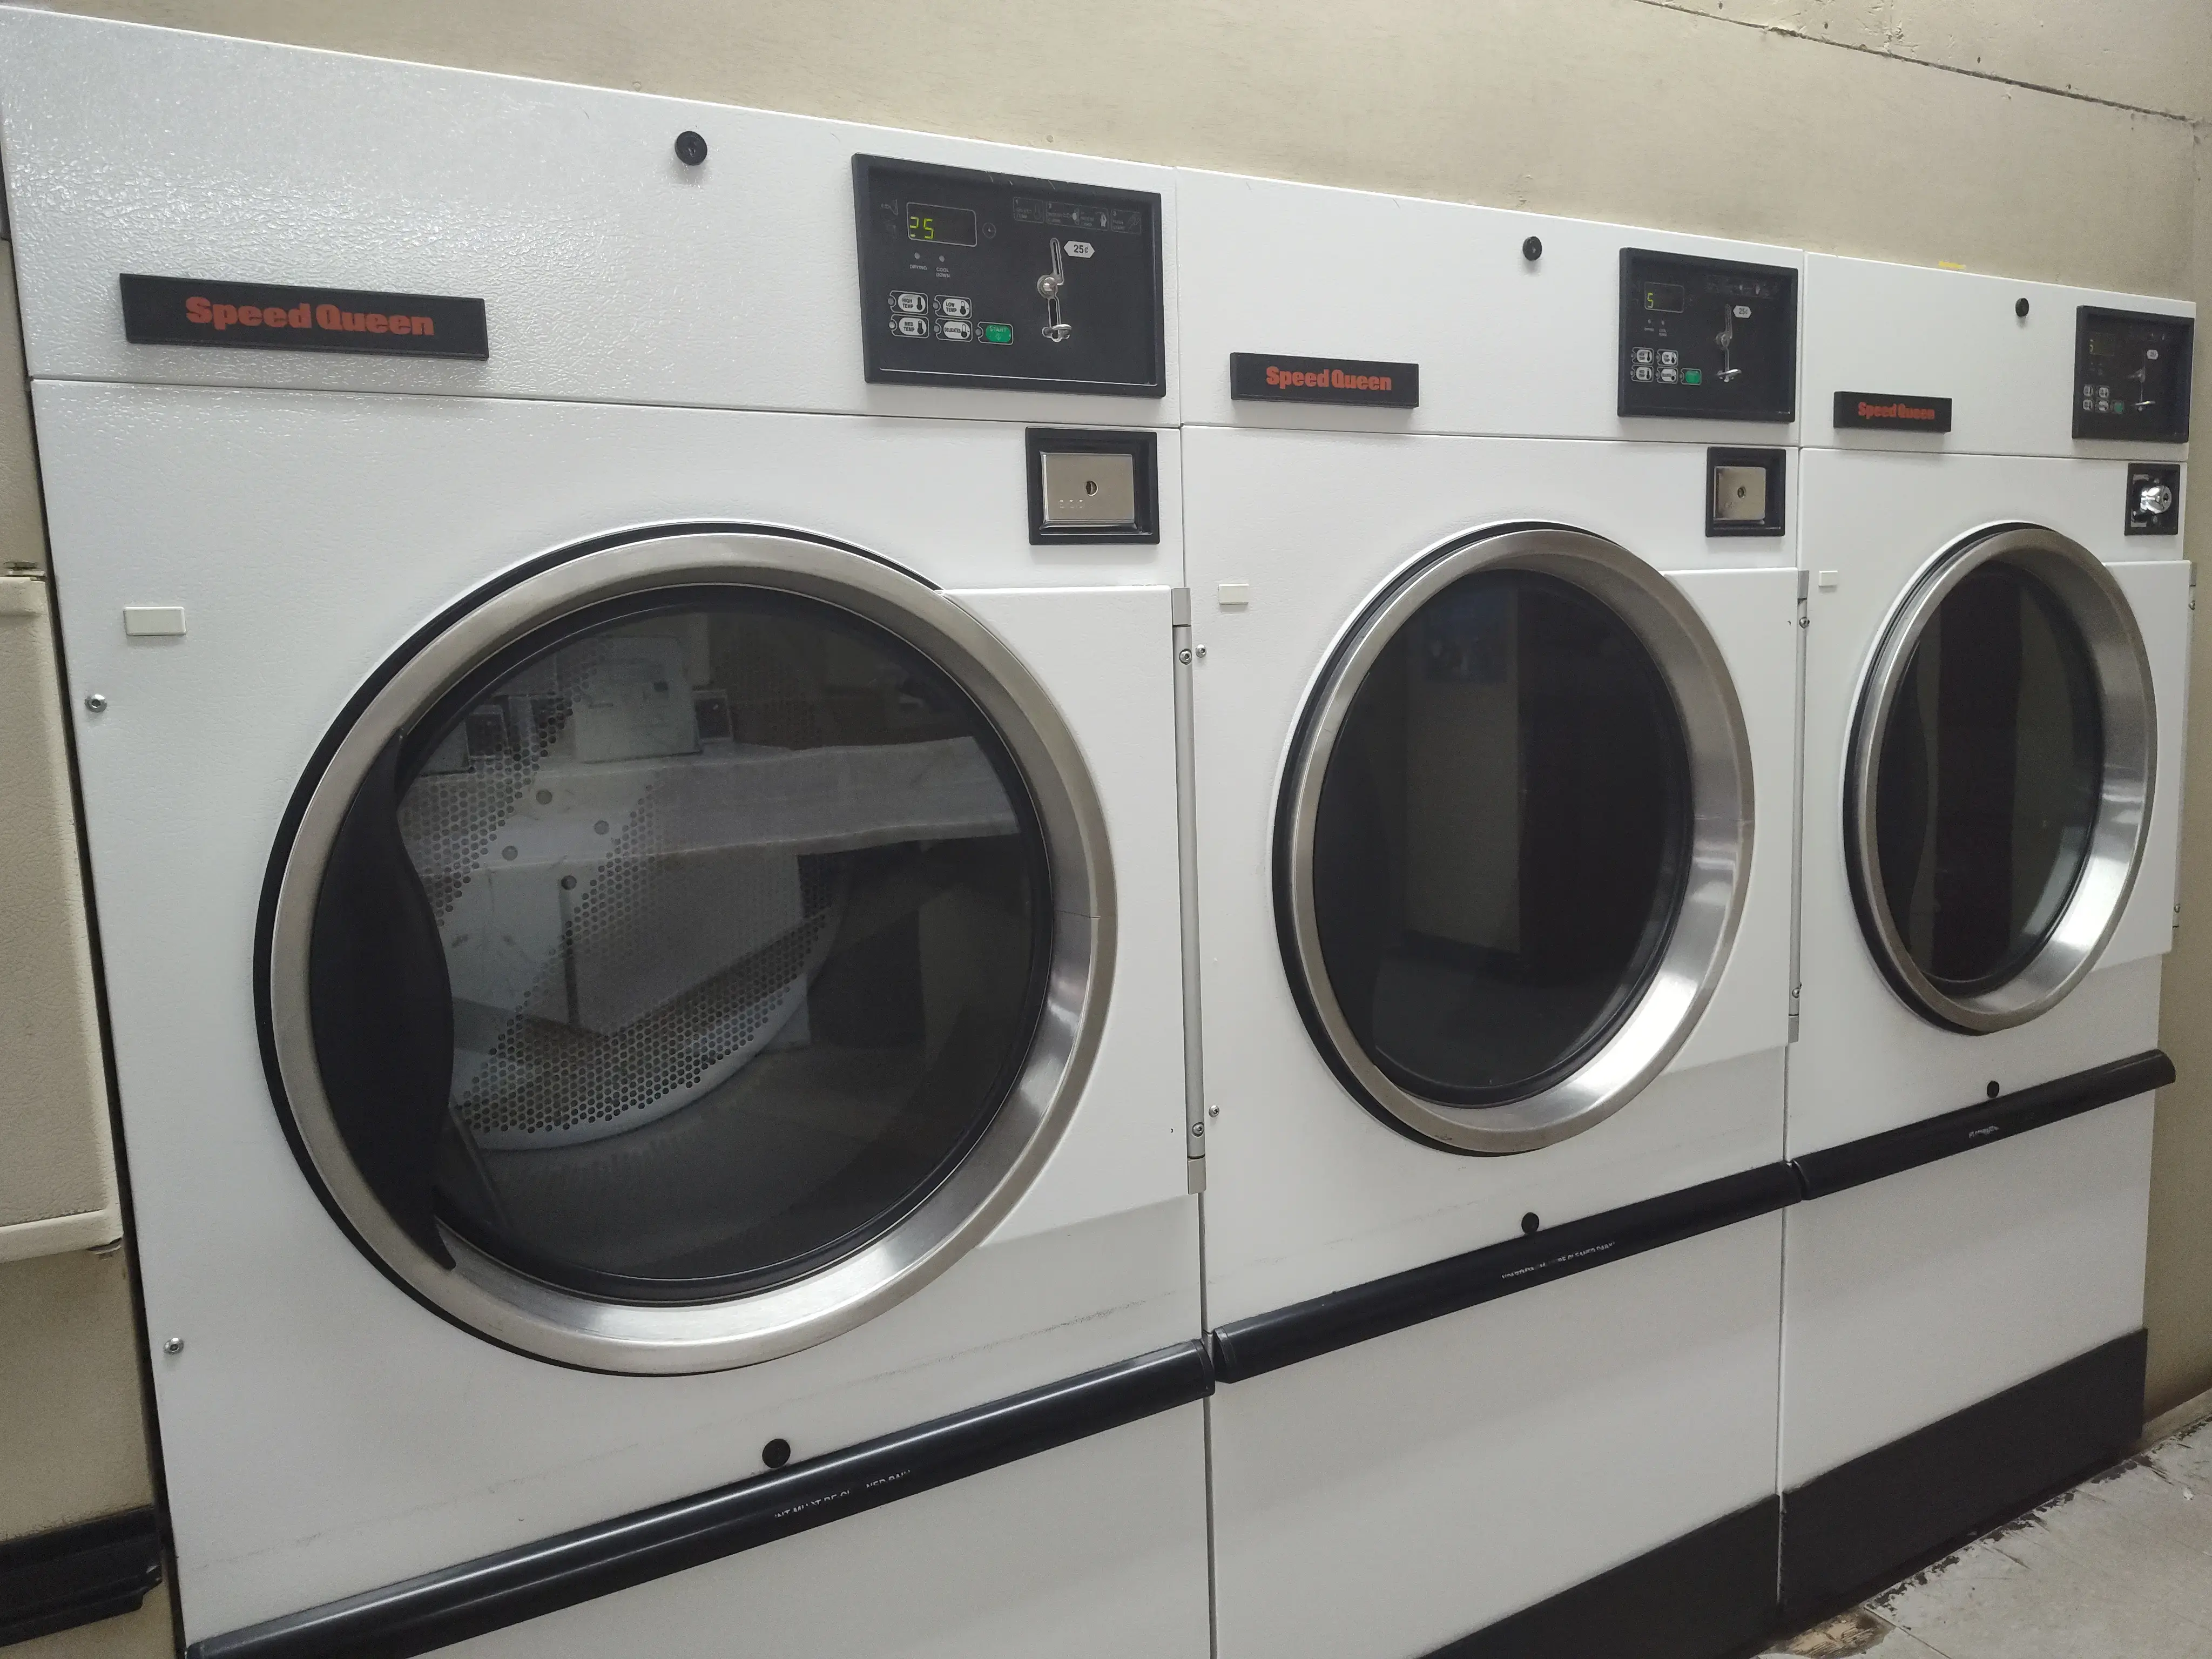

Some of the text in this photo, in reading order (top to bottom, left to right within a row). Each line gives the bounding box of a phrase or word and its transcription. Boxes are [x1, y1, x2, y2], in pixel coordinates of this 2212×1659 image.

[910, 216, 934, 239] 25
[1074, 244, 1089, 254] 25¢
[186, 296, 434, 335] Speed Queen
[1266, 366, 1392, 391] Speed Queen
[1858, 401, 1936, 420] Speed Queen
